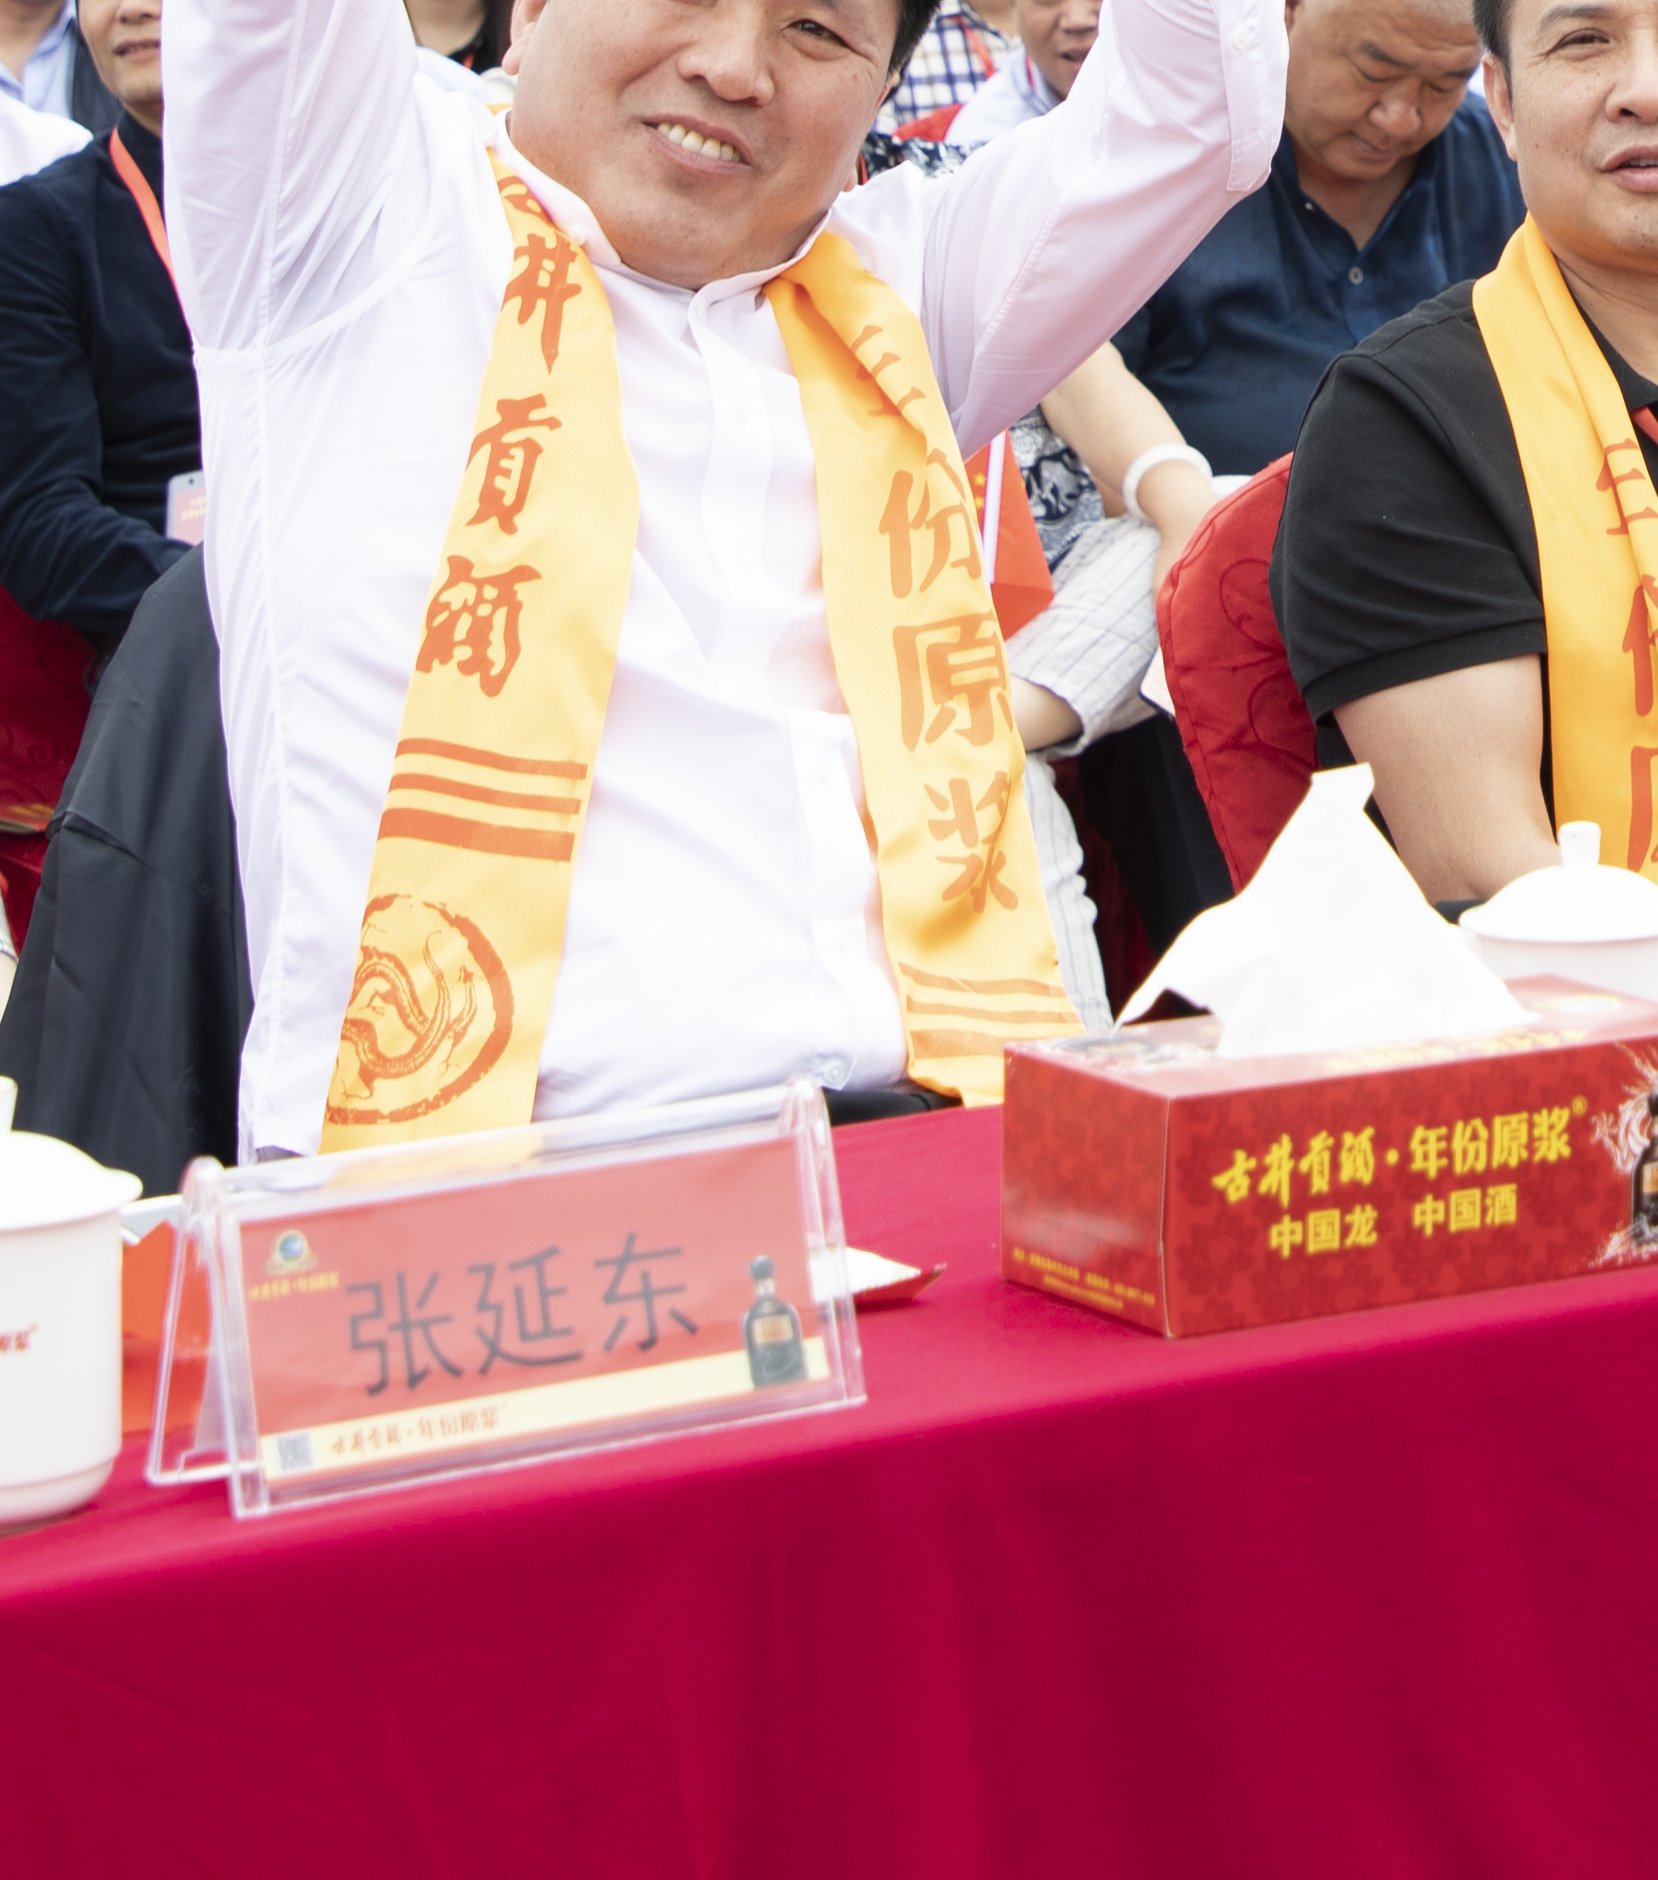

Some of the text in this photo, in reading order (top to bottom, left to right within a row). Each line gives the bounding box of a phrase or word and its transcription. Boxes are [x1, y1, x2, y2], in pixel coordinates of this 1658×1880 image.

[1270, 1182, 1518, 1259] 中国龙 中国酒
[346, 1231, 698, 1397] 张延东
